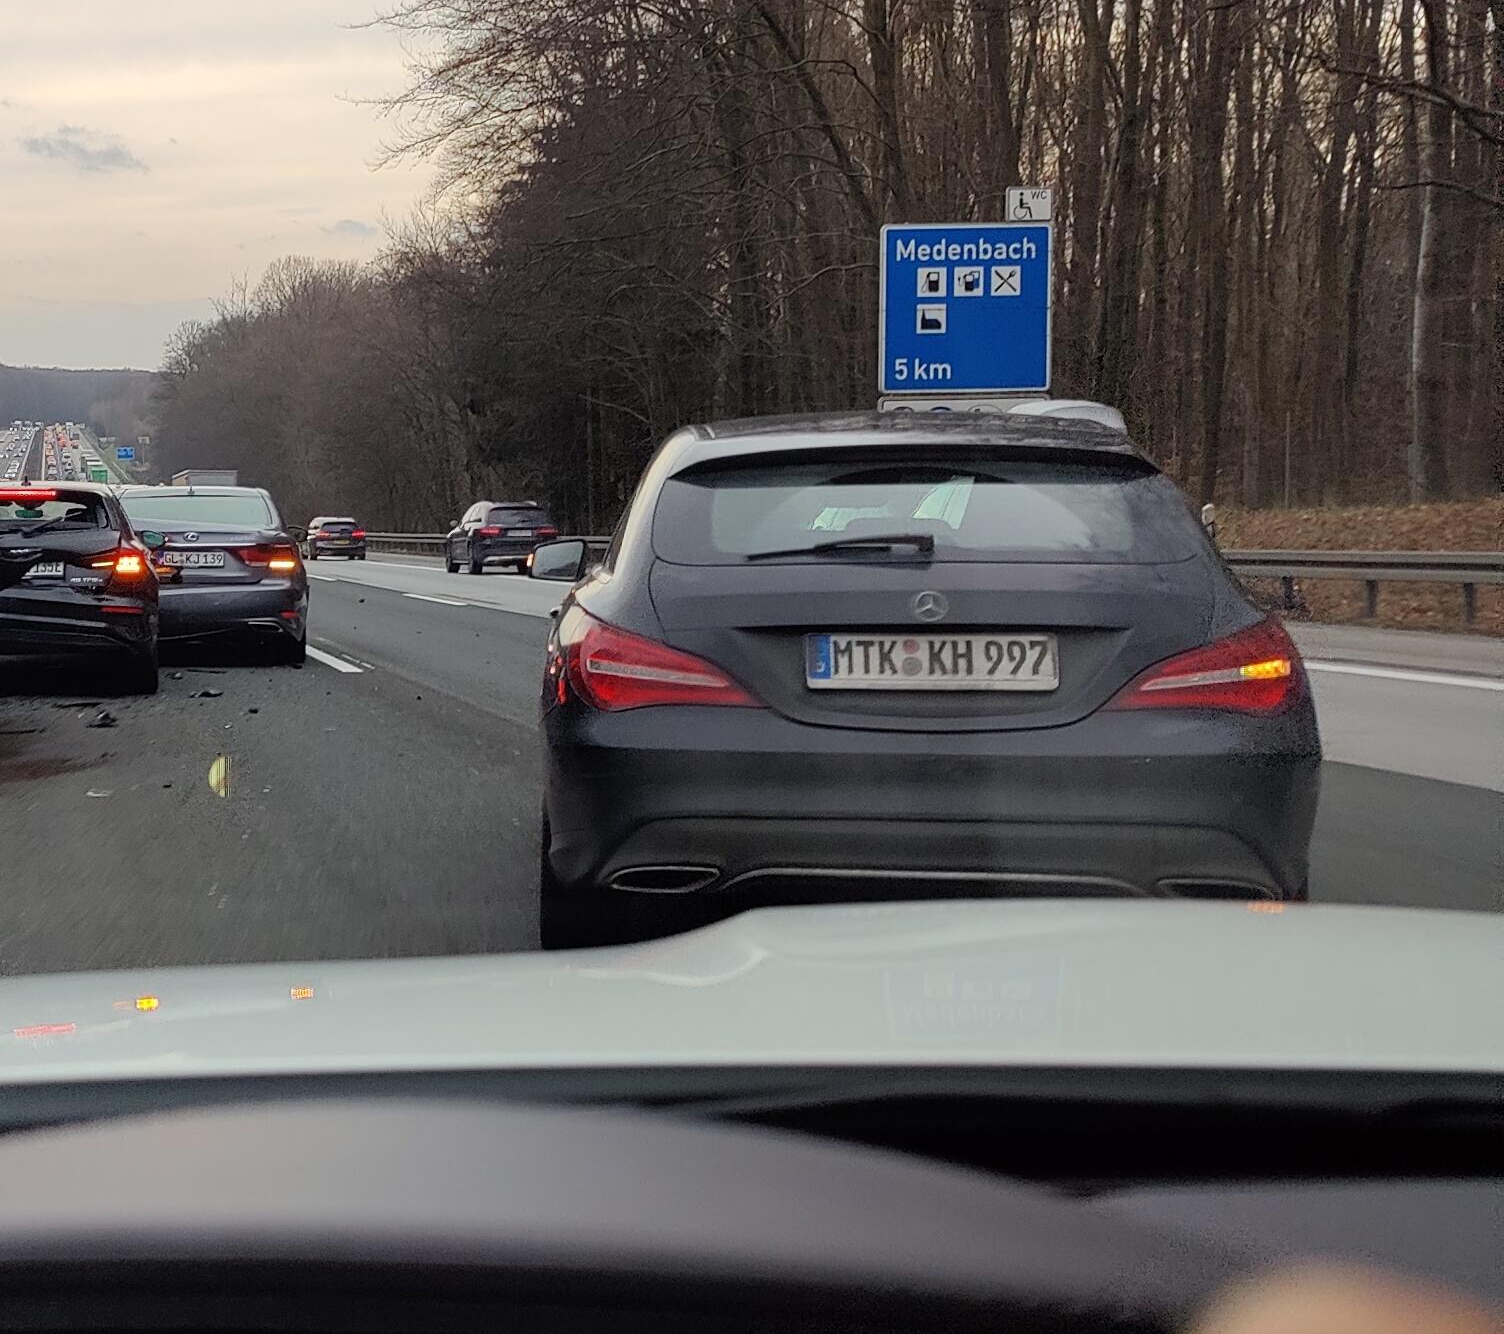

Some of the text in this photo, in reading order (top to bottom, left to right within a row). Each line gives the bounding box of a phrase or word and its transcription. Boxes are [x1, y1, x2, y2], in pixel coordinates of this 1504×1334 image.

[1031, 190, 1047, 200] WC
[896, 237, 1036, 262] Medenbach
[894, 357, 952, 381] 5 km
[165, 553, 223, 564] GL KJ 139
[833, 640, 1050, 676] MTK KH 997
